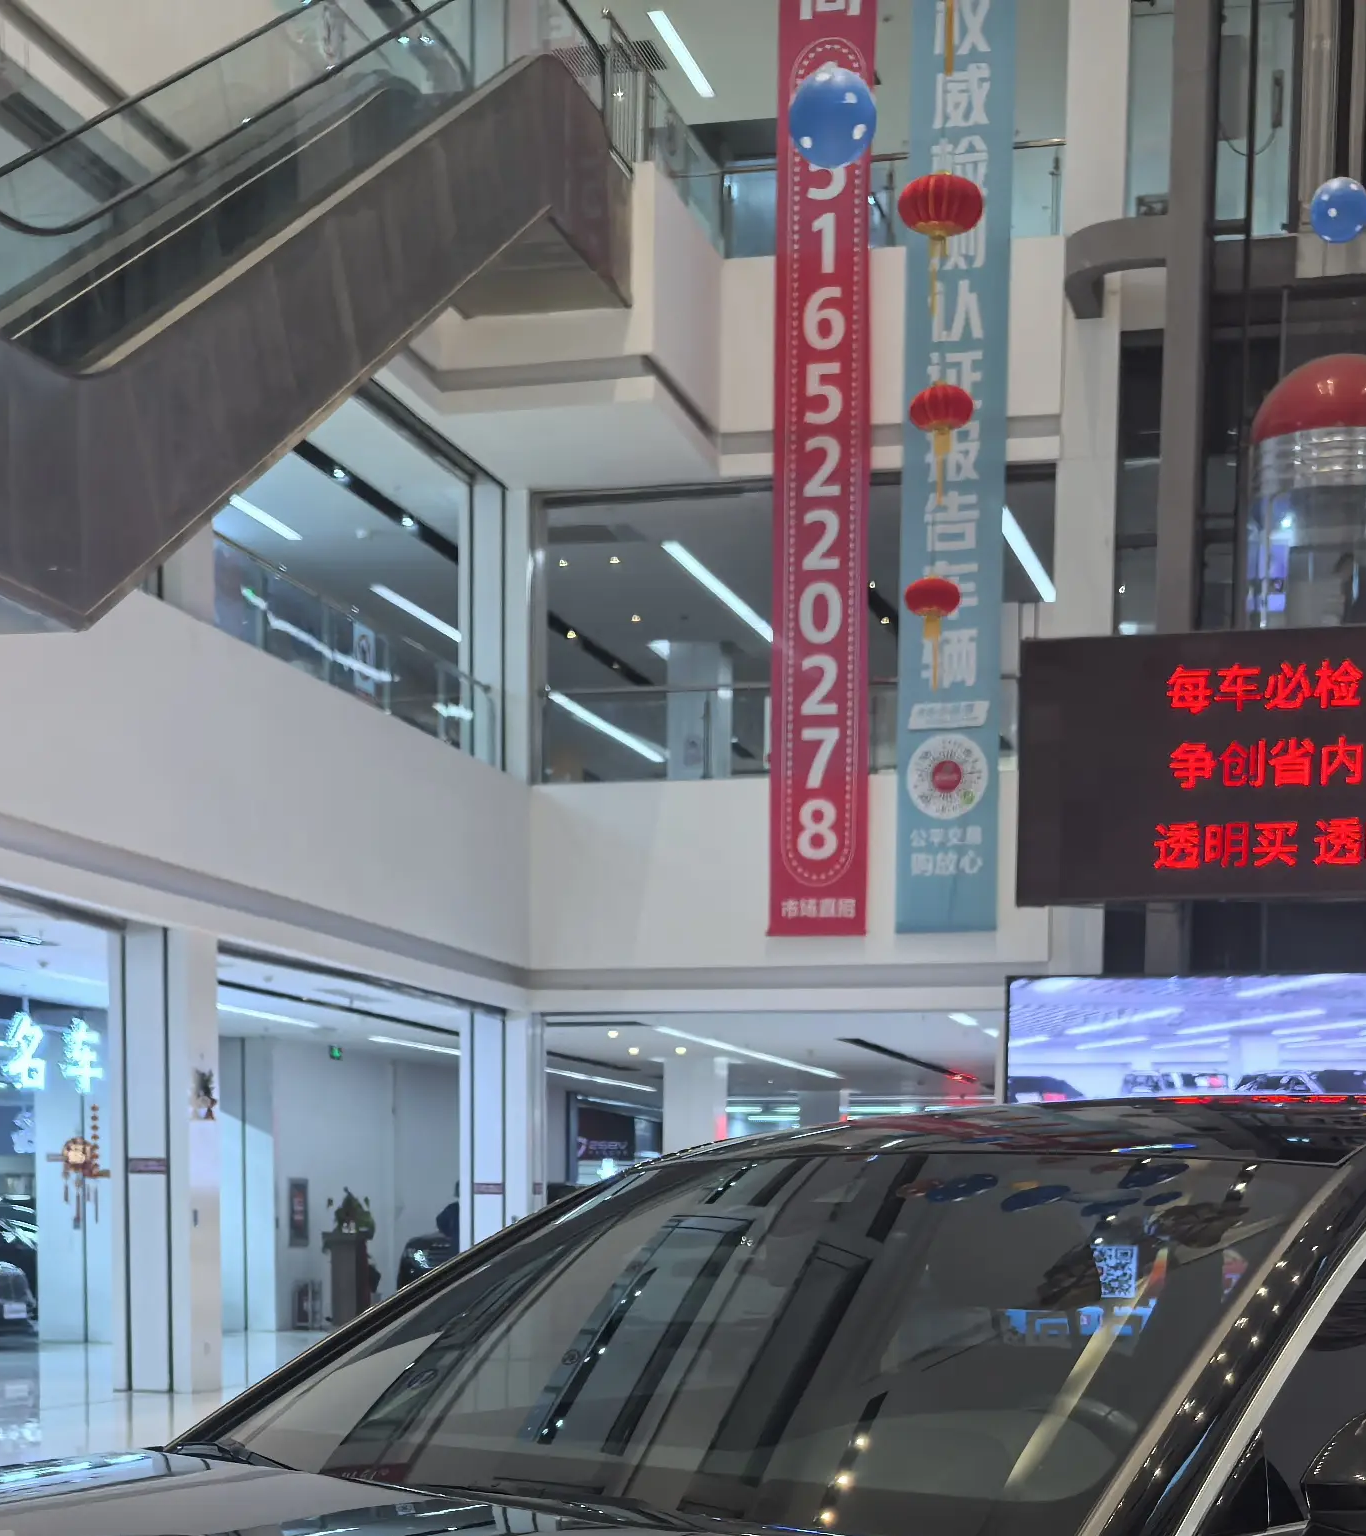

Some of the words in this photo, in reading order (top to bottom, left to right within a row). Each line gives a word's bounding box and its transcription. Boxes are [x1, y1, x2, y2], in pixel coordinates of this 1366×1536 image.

[797, 62, 848, 861] 5165220278
[1167, 661, 1362, 713] 每车必检
[1155, 823, 1297, 868] 透明买
